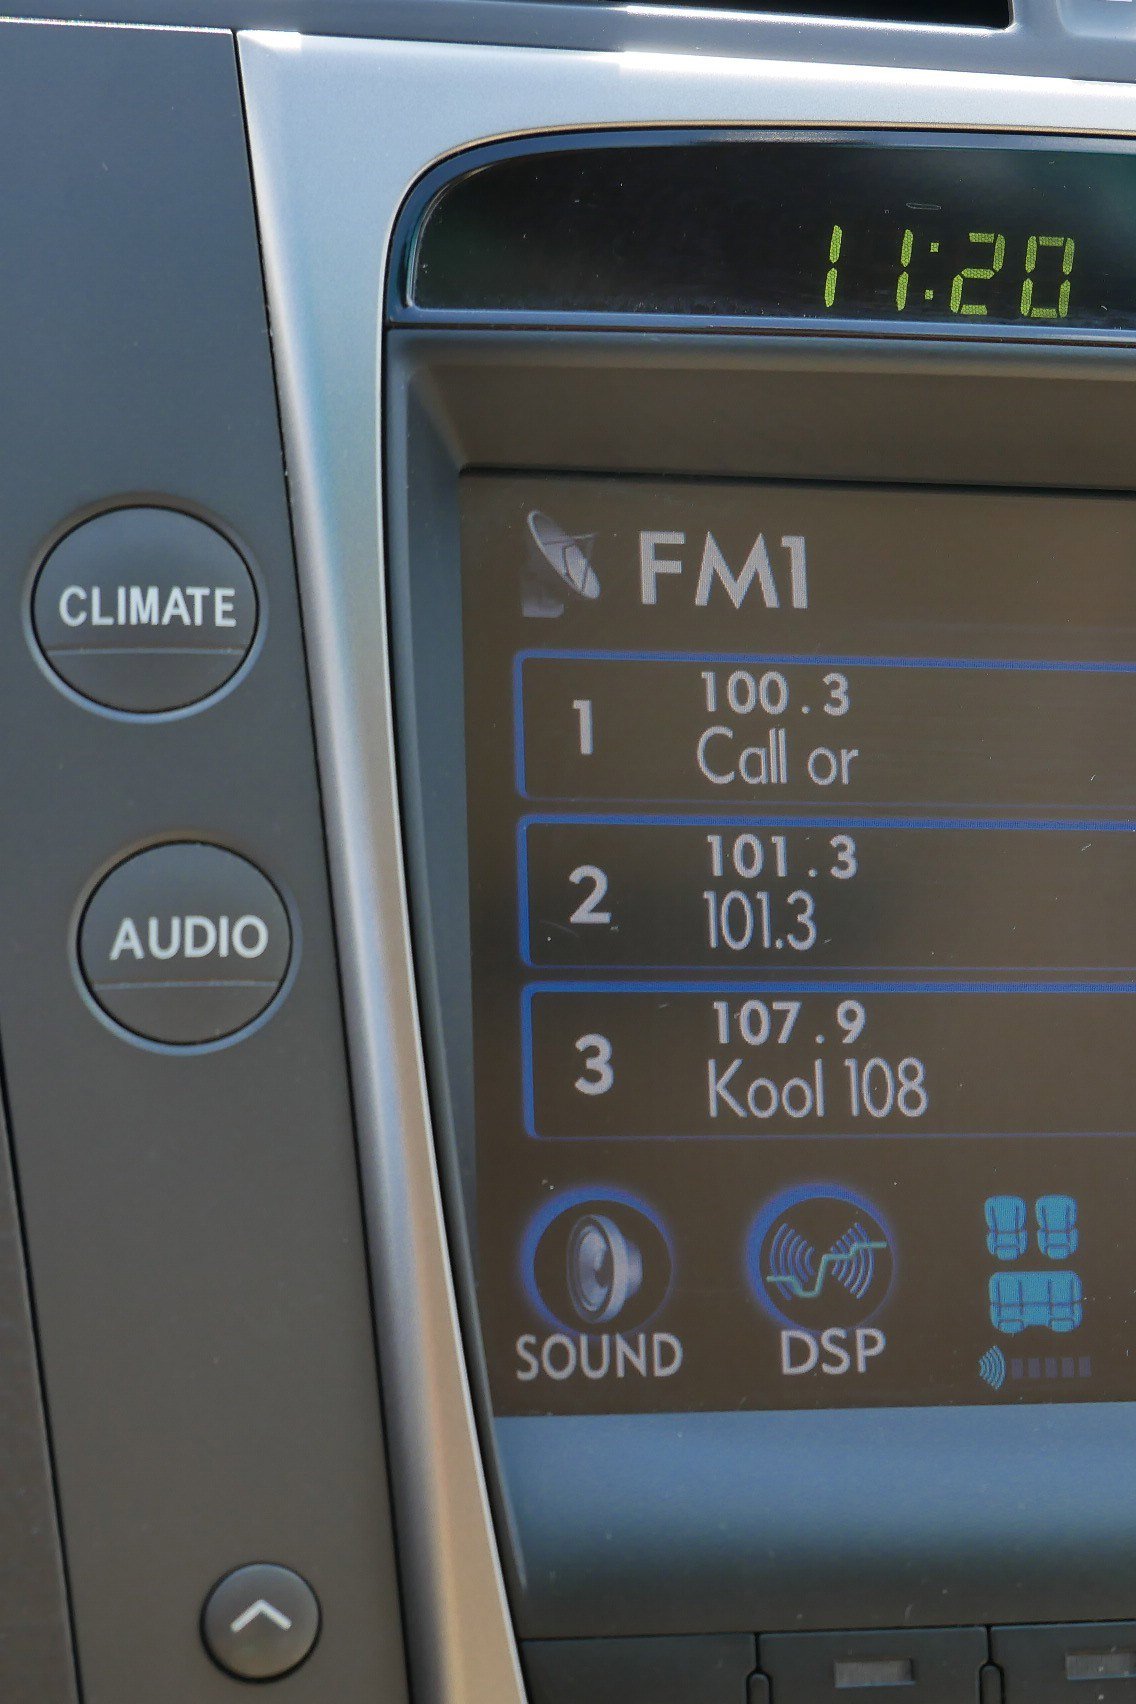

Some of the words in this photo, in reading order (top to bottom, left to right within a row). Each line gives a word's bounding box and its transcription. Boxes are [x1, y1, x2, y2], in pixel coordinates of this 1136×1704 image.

[823, 224, 1075, 319] 11:20
[638, 530, 809, 610] FM1
[58, 584, 238, 628] CLIMATE
[571, 699, 594, 755] 1
[696, 726, 788, 785] Call
[807, 745, 860, 786] or
[568, 865, 612, 924] 2
[702, 890, 818, 950] 101.3
[109, 914, 270, 961] AUDIO
[574, 1034, 615, 1096] 3
[706, 1058, 825, 1120] Kool
[844, 1057, 930, 1120] 108
[515, 1332, 684, 1381] SOUND
[779, 1327, 887, 1376] DSP
